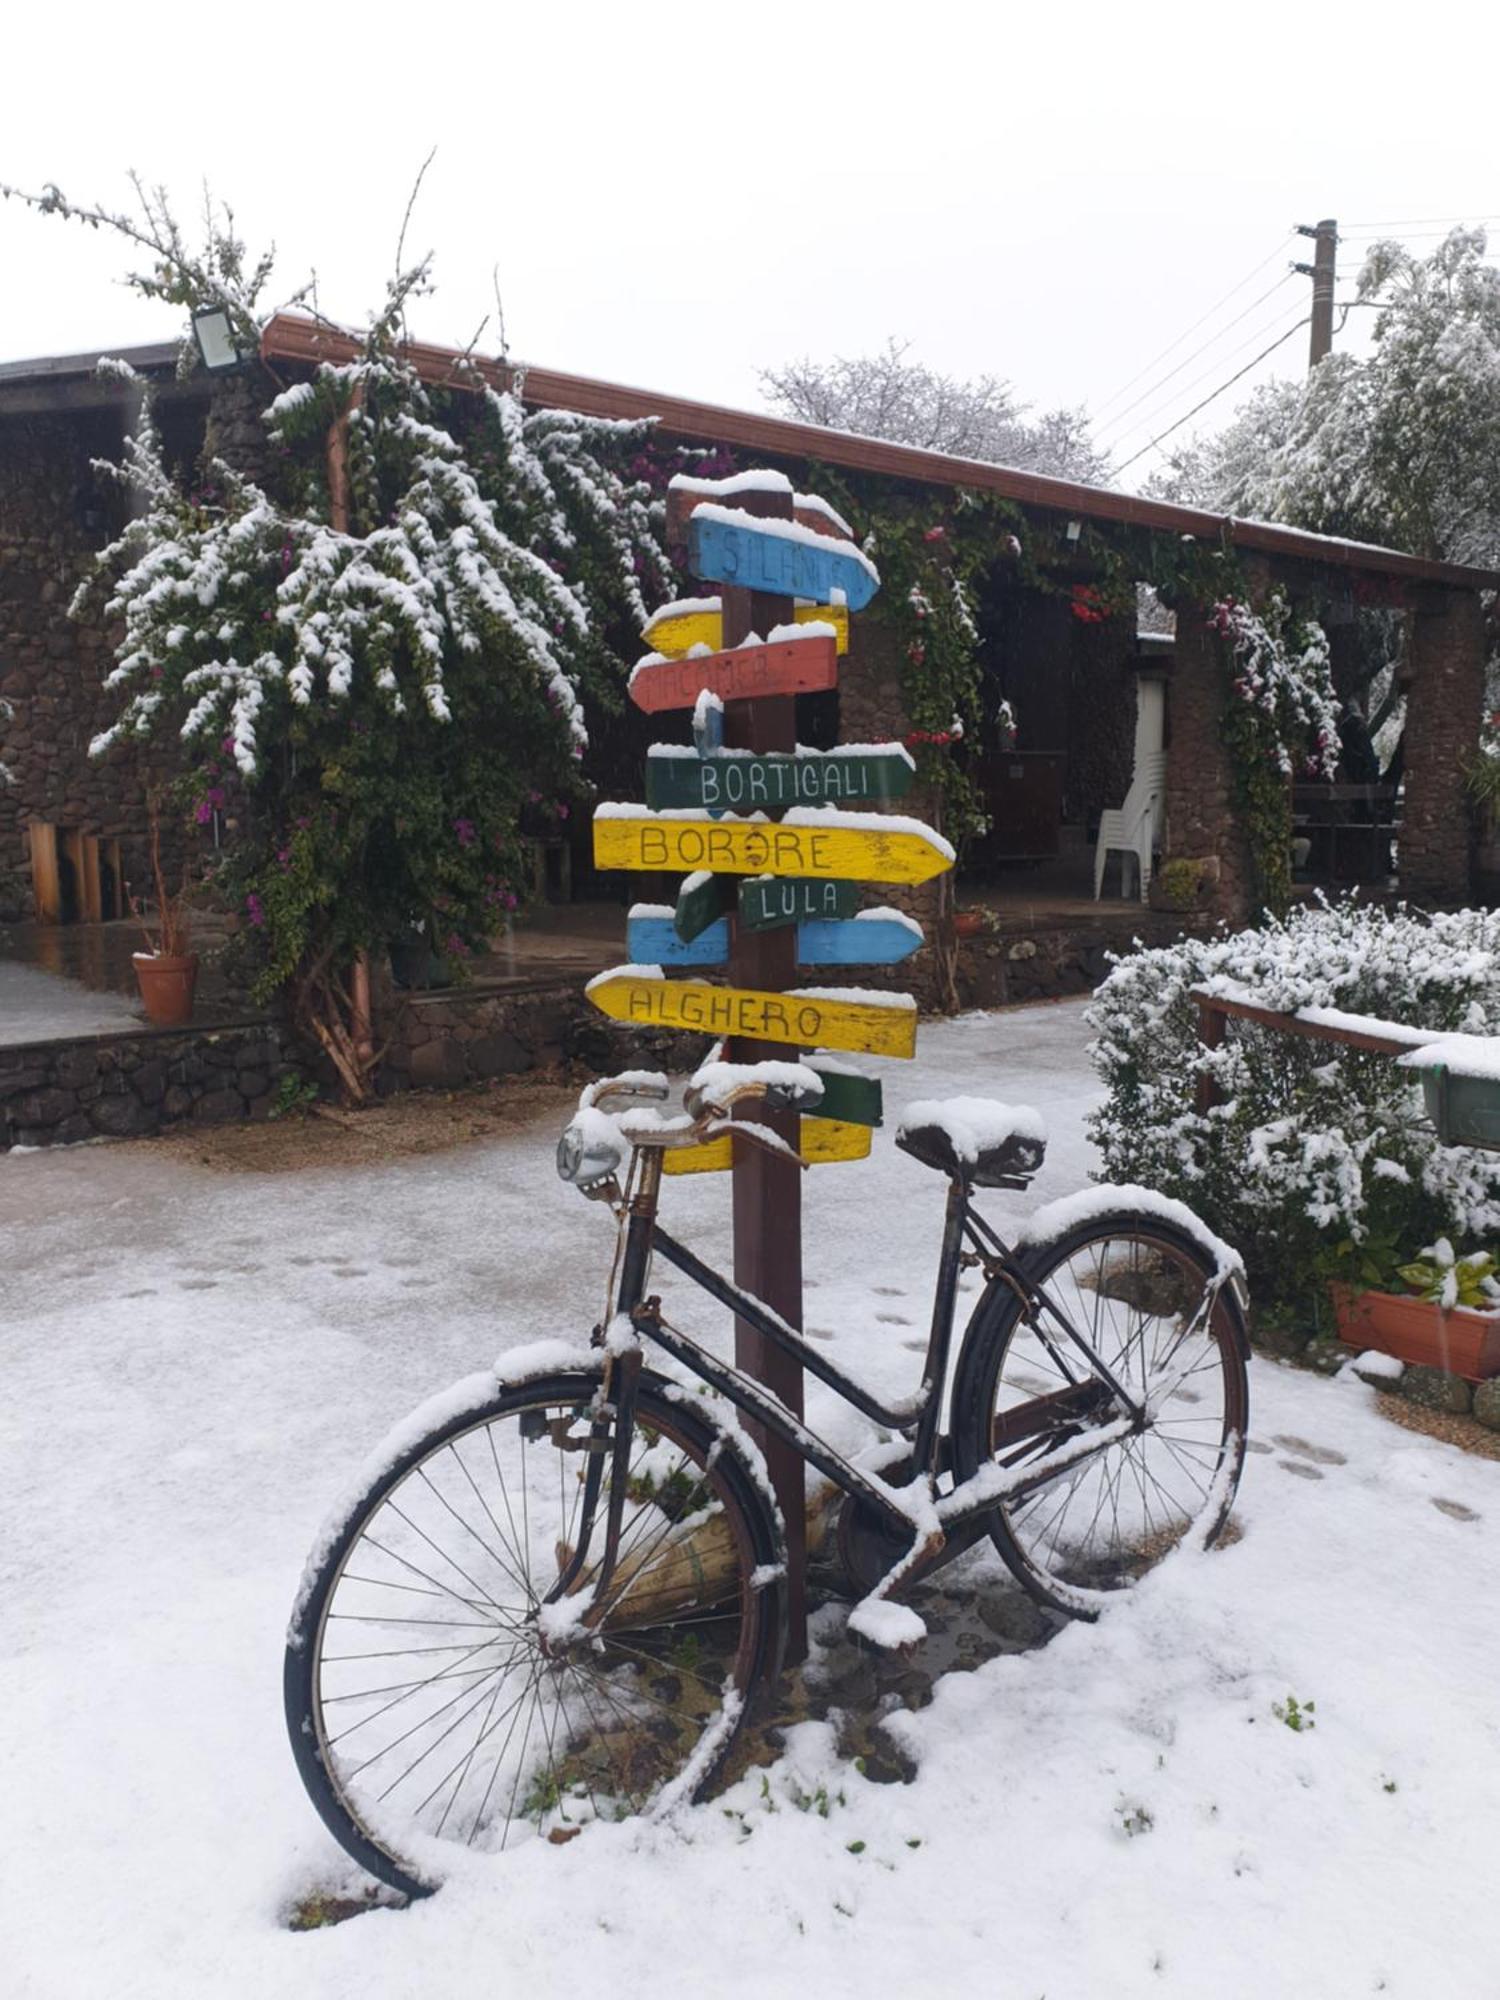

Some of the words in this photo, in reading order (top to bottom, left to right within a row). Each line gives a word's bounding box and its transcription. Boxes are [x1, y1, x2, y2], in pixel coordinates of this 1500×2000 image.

[701, 763, 868, 804] BORTIGALI
[640, 827, 832, 869] BORORE
[760, 883, 837, 919] LULA
[629, 989, 822, 1037] ALGHERO
